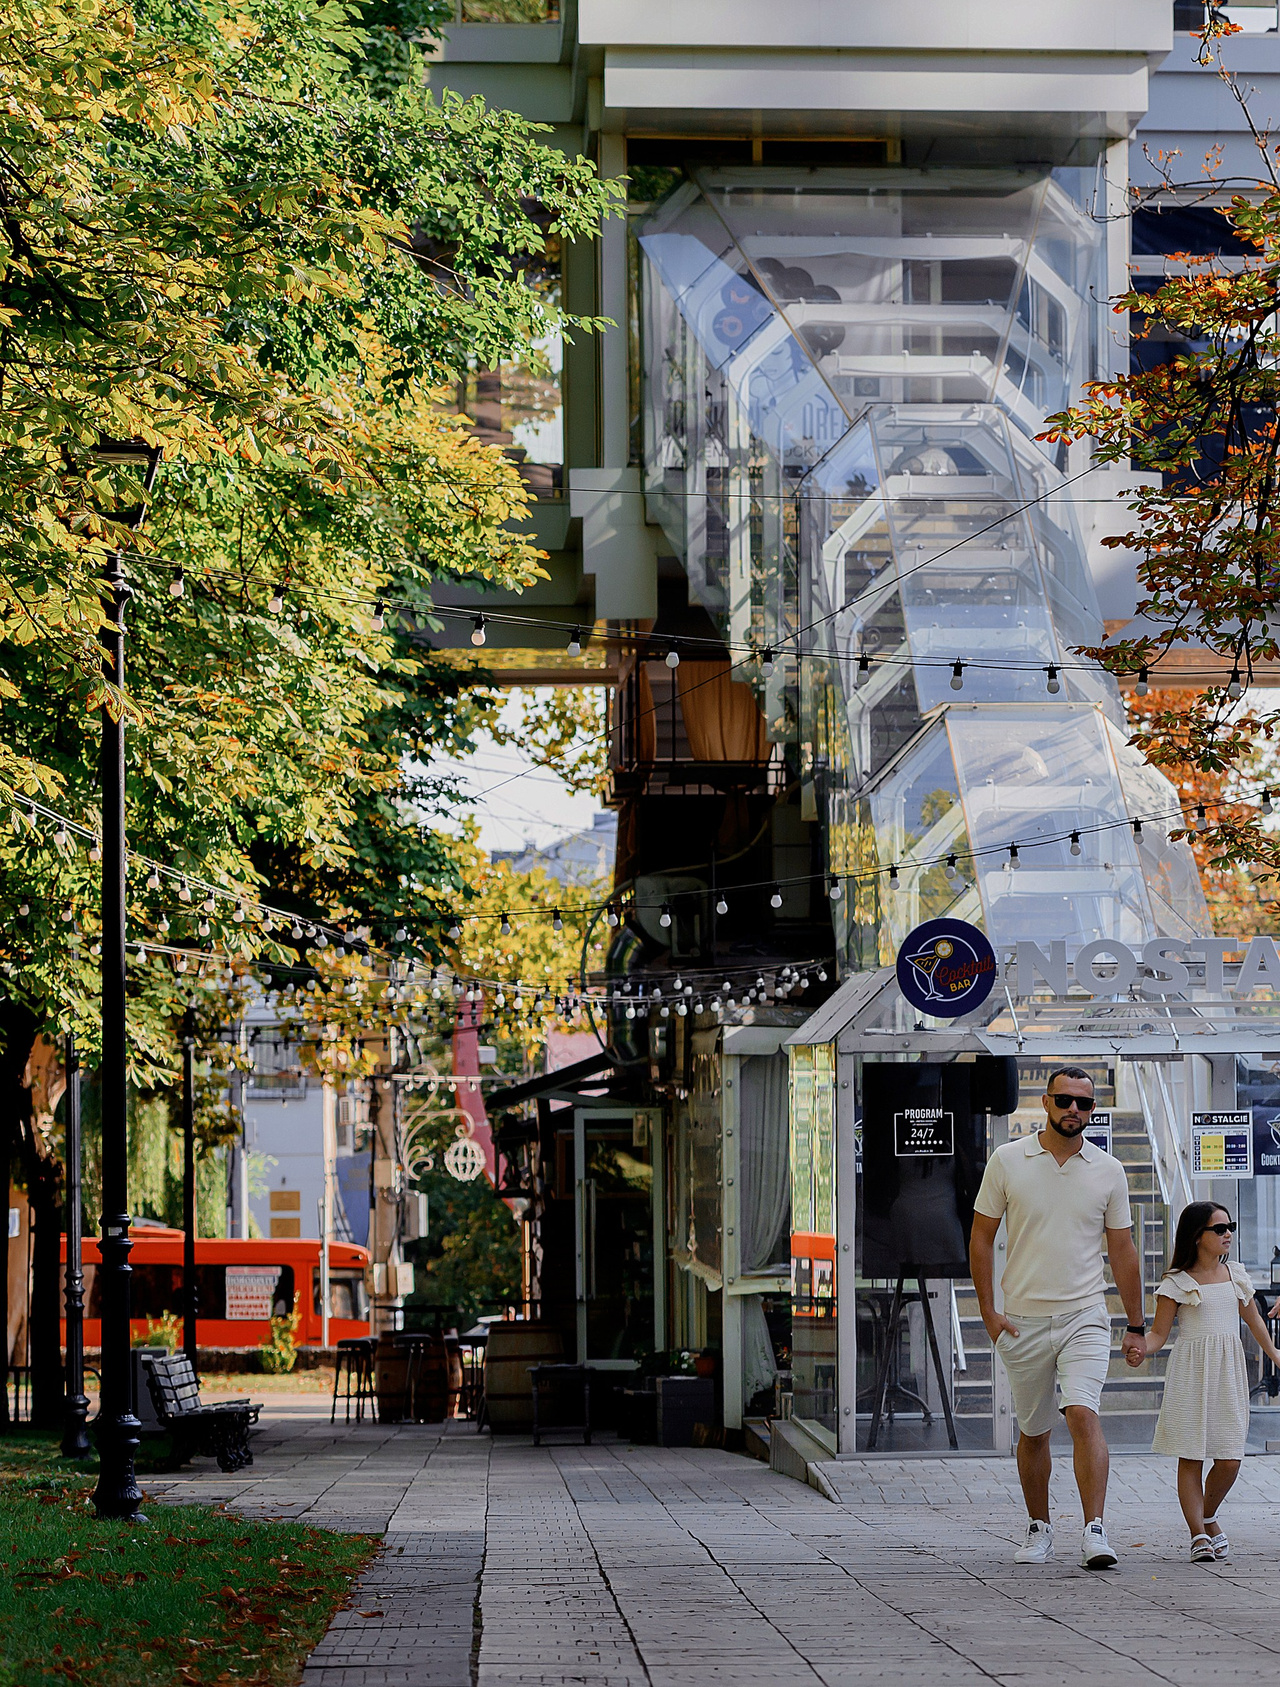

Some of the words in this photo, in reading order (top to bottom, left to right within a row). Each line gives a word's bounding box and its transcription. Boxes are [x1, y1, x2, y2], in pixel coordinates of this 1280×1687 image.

[935, 955, 995, 986] Cocktail
[949, 979, 971, 992] BAR
[904, 1108, 943, 1119] PROGRAM
[911, 1128, 935, 1139] 24/7
